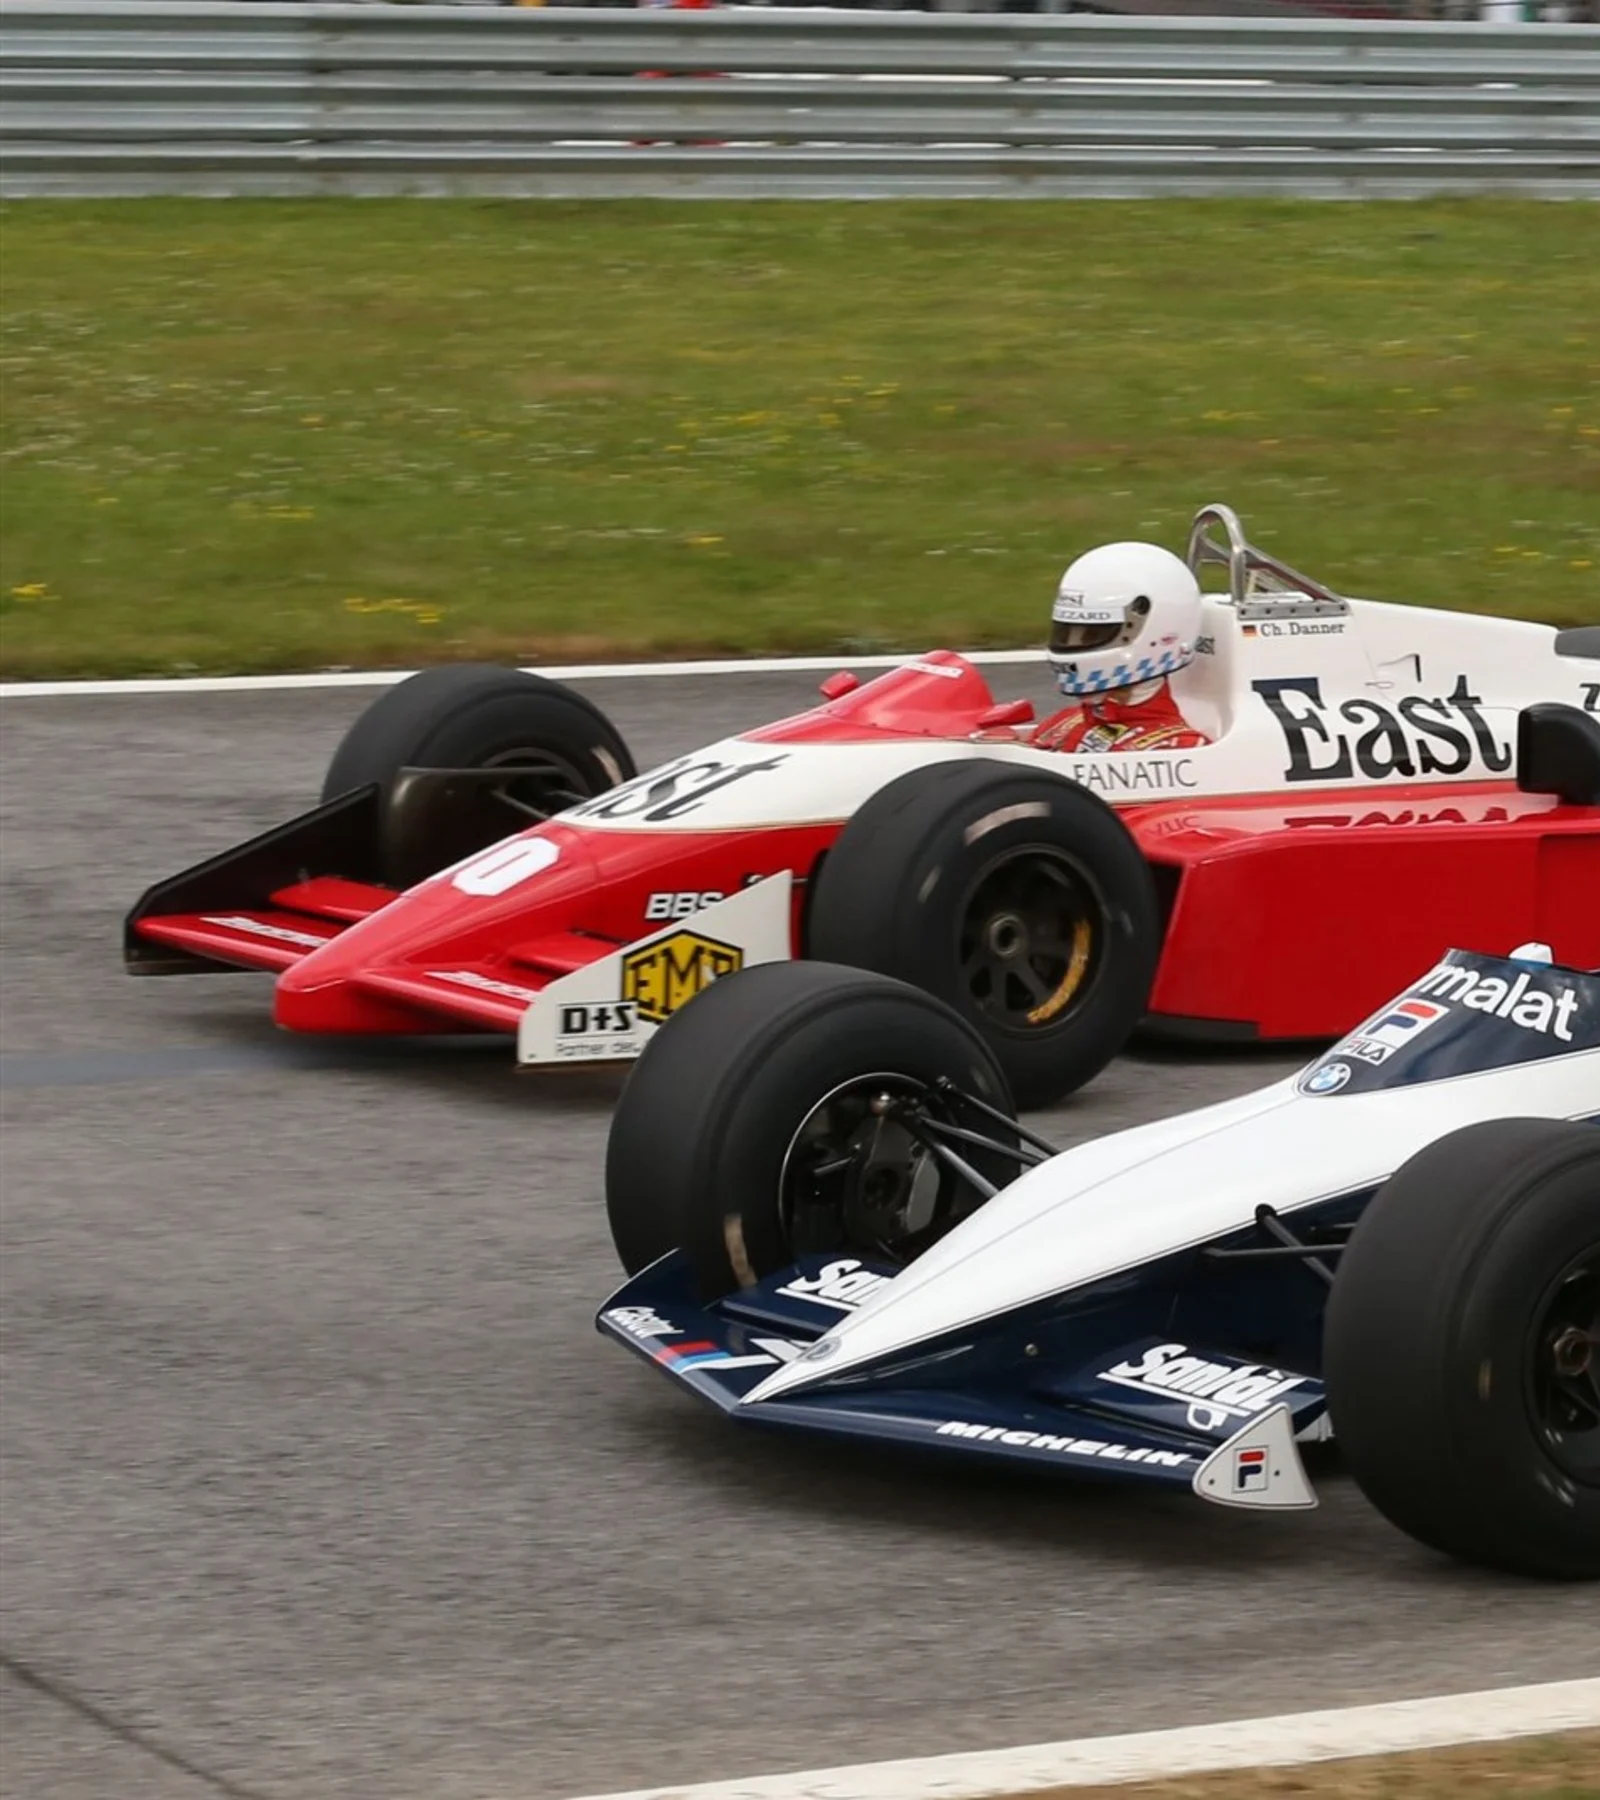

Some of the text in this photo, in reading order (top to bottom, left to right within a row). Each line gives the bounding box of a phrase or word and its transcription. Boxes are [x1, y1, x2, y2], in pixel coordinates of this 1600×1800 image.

[1260, 622, 1345, 637] Ch. Danner
[1251, 674, 1512, 782] East
[1073, 758, 1199, 791] FANATIC
[936, 1420, 1193, 1468] MICHELIN
